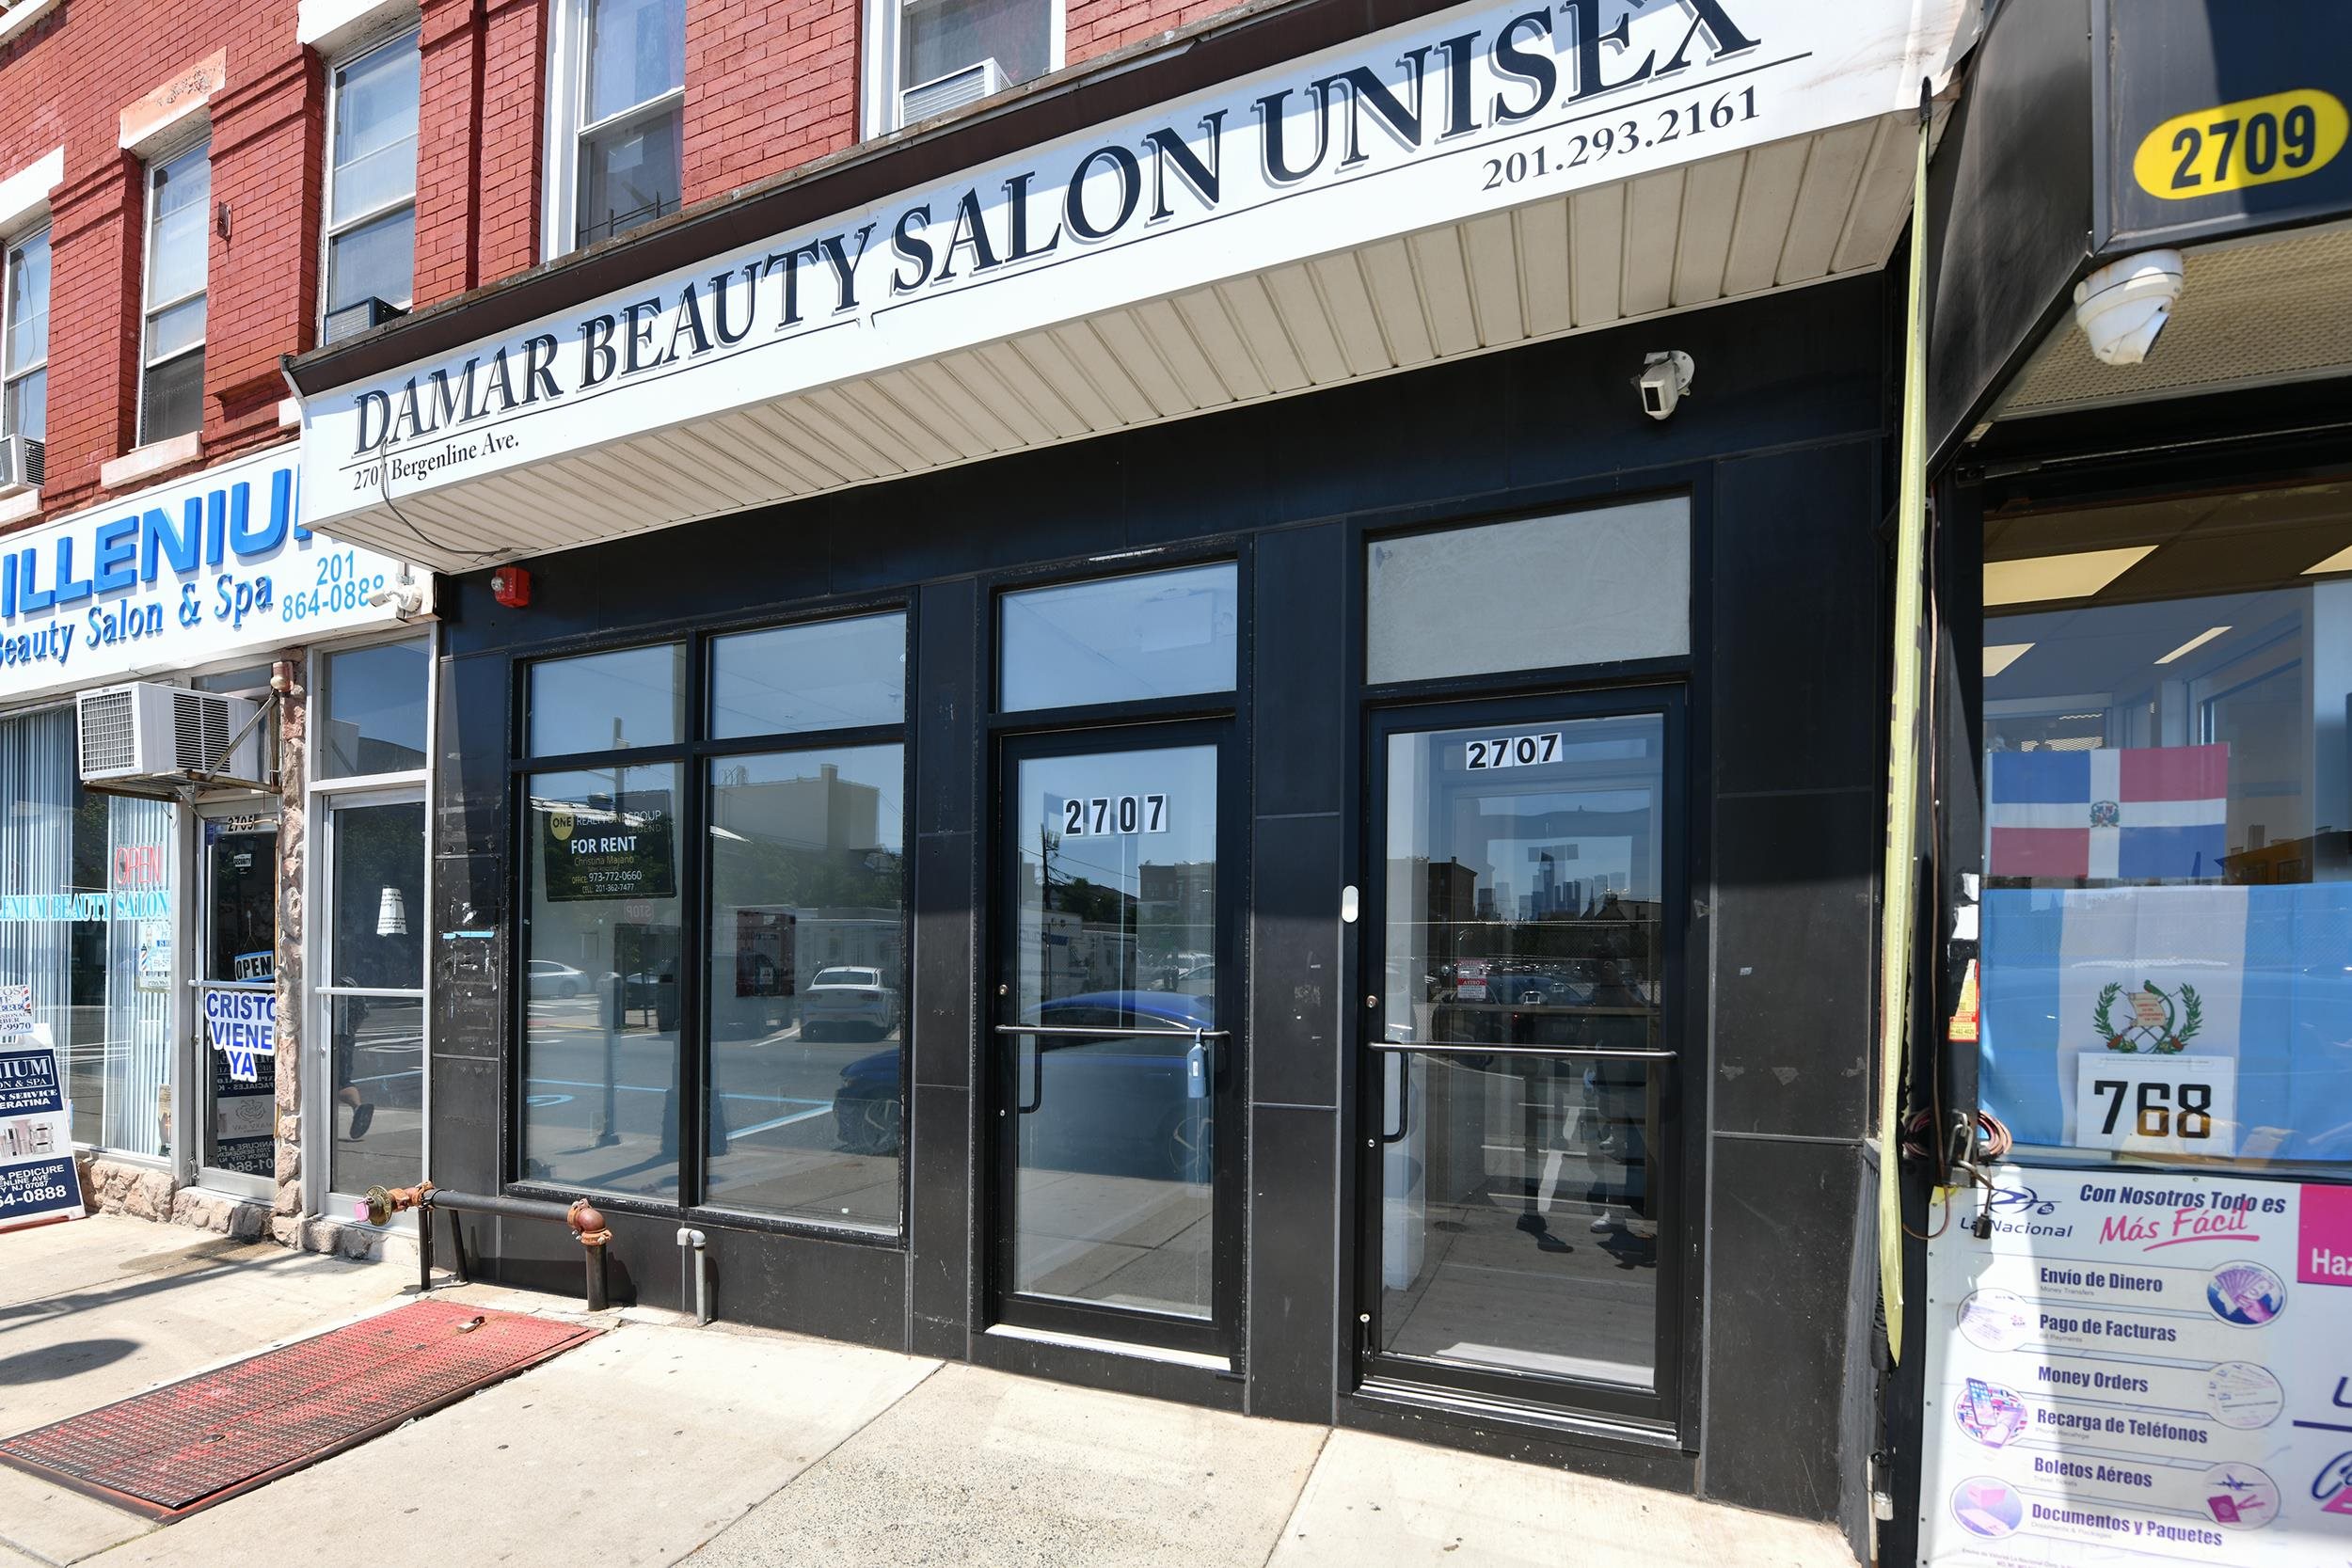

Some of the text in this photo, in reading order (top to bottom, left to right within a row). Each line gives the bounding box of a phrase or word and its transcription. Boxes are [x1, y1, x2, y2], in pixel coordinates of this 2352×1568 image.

[1482, 84, 1760, 191] 201.293.2161
[2170, 104, 2315, 190] 2709
[352, 0, 1762, 458] DAMAR BEAUTY SALON UNISEX
[391, 444, 477, 482] Bergenline
[480, 432, 519, 456] Ave.
[1, 463, 312, 618] ILLENIU
[316, 549, 354, 586] 201
[0, 573, 274, 667] eauty Salon & Spa
[1467, 733, 1562, 769] 2707
[228, 816, 254, 832] 2705
[552, 817, 572, 829] ONE
[1064, 794, 1167, 835] 2707
[570, 836, 637, 854] FOR RENT
[114, 845, 163, 884] OPEN
[588, 870, 643, 882] 973-772-0660
[0, 891, 170, 920] ENIUM BEAUTY SALON
[235, 955, 273, 980] OPEN
[212, 1021, 273, 1050] VIENE
[229, 1051, 255, 1077] YA
[9, 1088, 57, 1101] SERVICE
[26, 1078, 47, 1086] SPA
[2093, 1080, 2212, 1139] 768
[8, 1164, 65, 1180] PEDICURE
[25, 1180, 49, 1189] 07087
[2080, 1184, 2286, 1213] Con Nosotros Todo es
[1990, 1219, 2074, 1237] Nacional
[2099, 1200, 2249, 1244] Más Fácil
[2040, 1267, 2163, 1292] Envío de Dinero
[2041, 1286, 2069, 1295] Money
[2040, 1313, 2177, 1342] Pago de Facturas
[2038, 1366, 2149, 1393] Money Orders
[2037, 1408, 2208, 1444] Recarga de Teléfonos
[2034, 1456, 2153, 1488] Boletos Aéreos
[2032, 1503, 2223, 1546] Documentos y Paquetes
